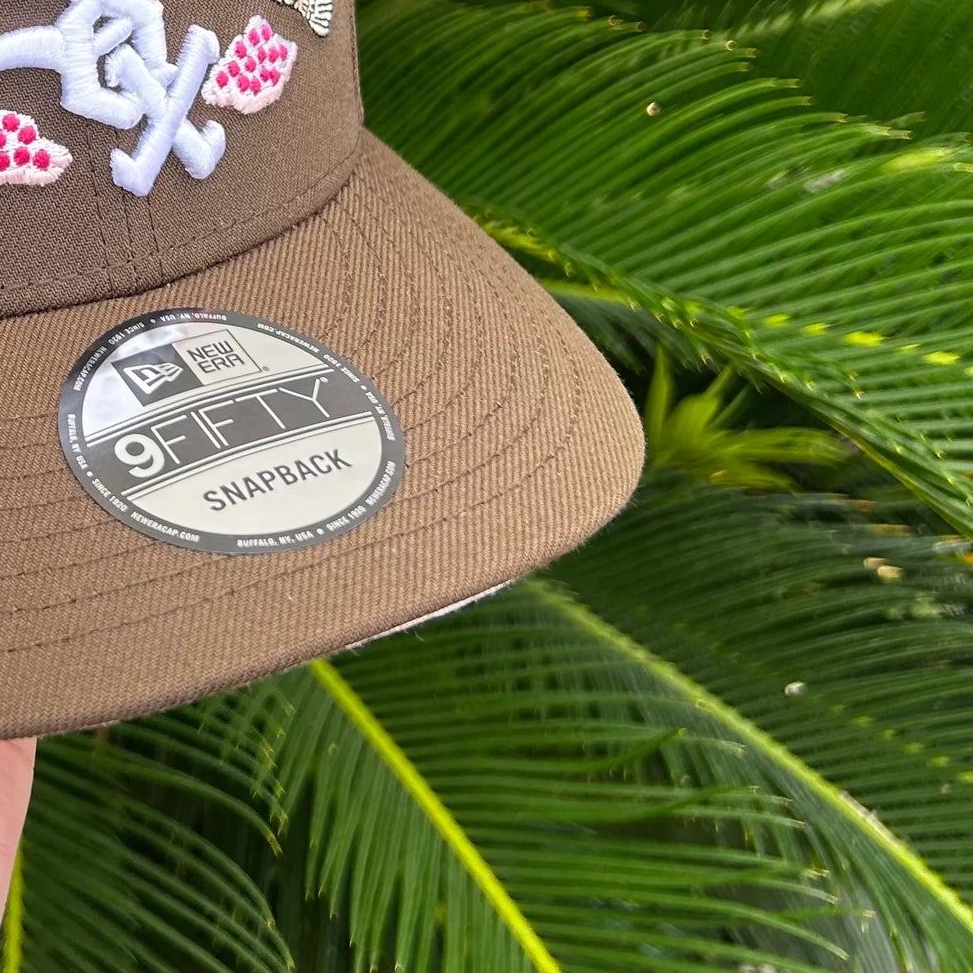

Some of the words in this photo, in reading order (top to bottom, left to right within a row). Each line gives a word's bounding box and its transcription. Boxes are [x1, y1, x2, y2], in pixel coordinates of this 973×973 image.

[187, 340, 234, 362] NEW
[197, 353, 245, 374] ERA
[202, 448, 353, 512] SNAPBACK
